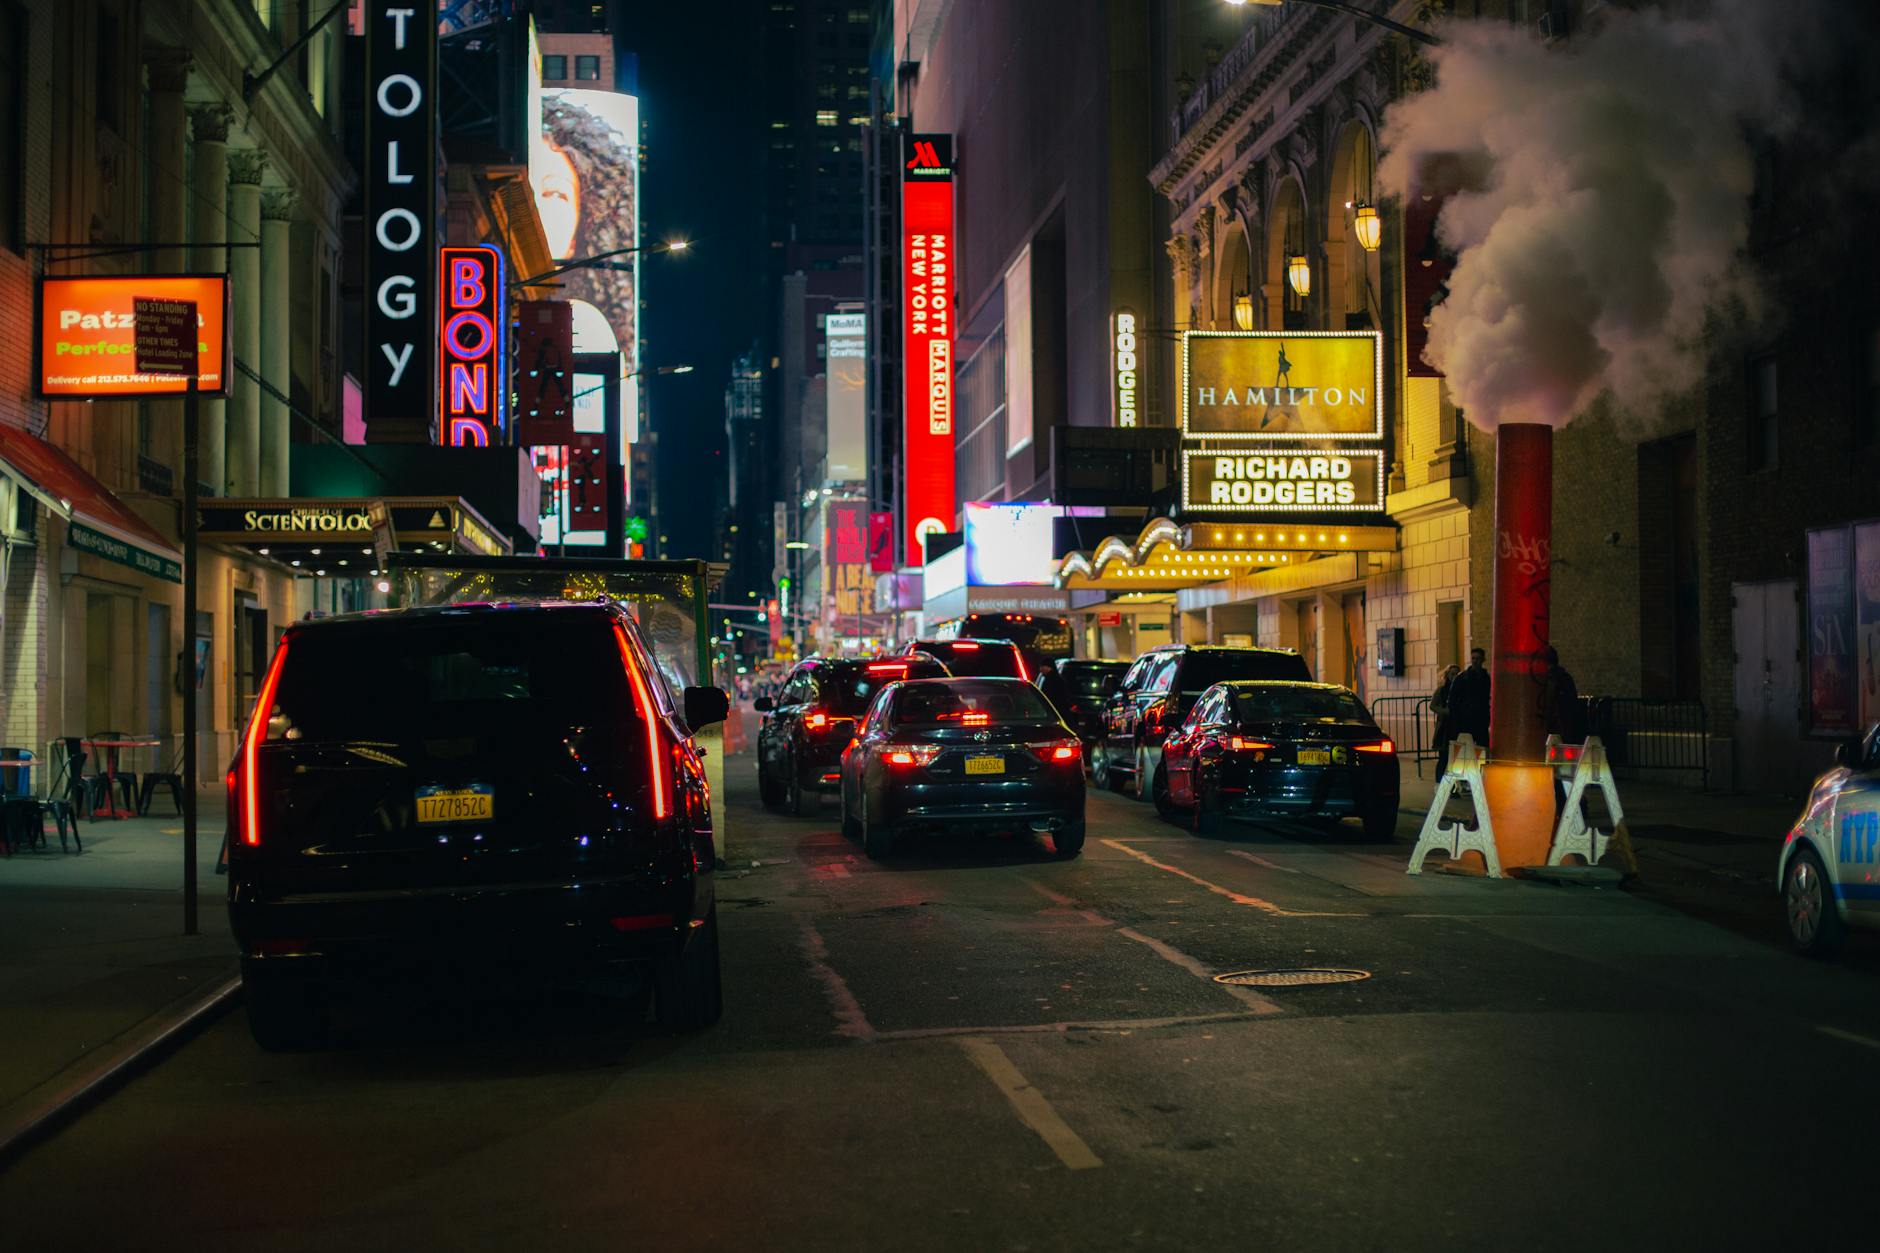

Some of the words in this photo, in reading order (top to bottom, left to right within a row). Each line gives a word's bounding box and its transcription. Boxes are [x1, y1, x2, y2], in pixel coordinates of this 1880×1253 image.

[913, 167, 951, 175] MARRIOTT
[911, 234, 926, 276] NEW
[931, 234, 947, 336] MARRIOTT
[137, 302, 148, 311] NO
[149, 303, 188, 314] STANDING
[911, 282, 927, 335] YORK
[830, 319, 863, 328] MoMA
[56, 340, 136, 355] Perfec
[137, 337, 158, 346] OTHER
[160, 338, 179, 347] TIMES
[444, 256, 494, 447] BOND
[47, 376, 80, 385] Delivery
[82, 375, 97, 384] call
[1117, 313, 1136, 428] RODGER
[932, 343, 948, 433] MARQUIS
[1197, 386, 1366, 407] HAMILTON
[1214, 456, 1352, 480] RICHARD
[1210, 480, 1355, 505] RODGERS
[422, 797, 486, 819] T727852C
